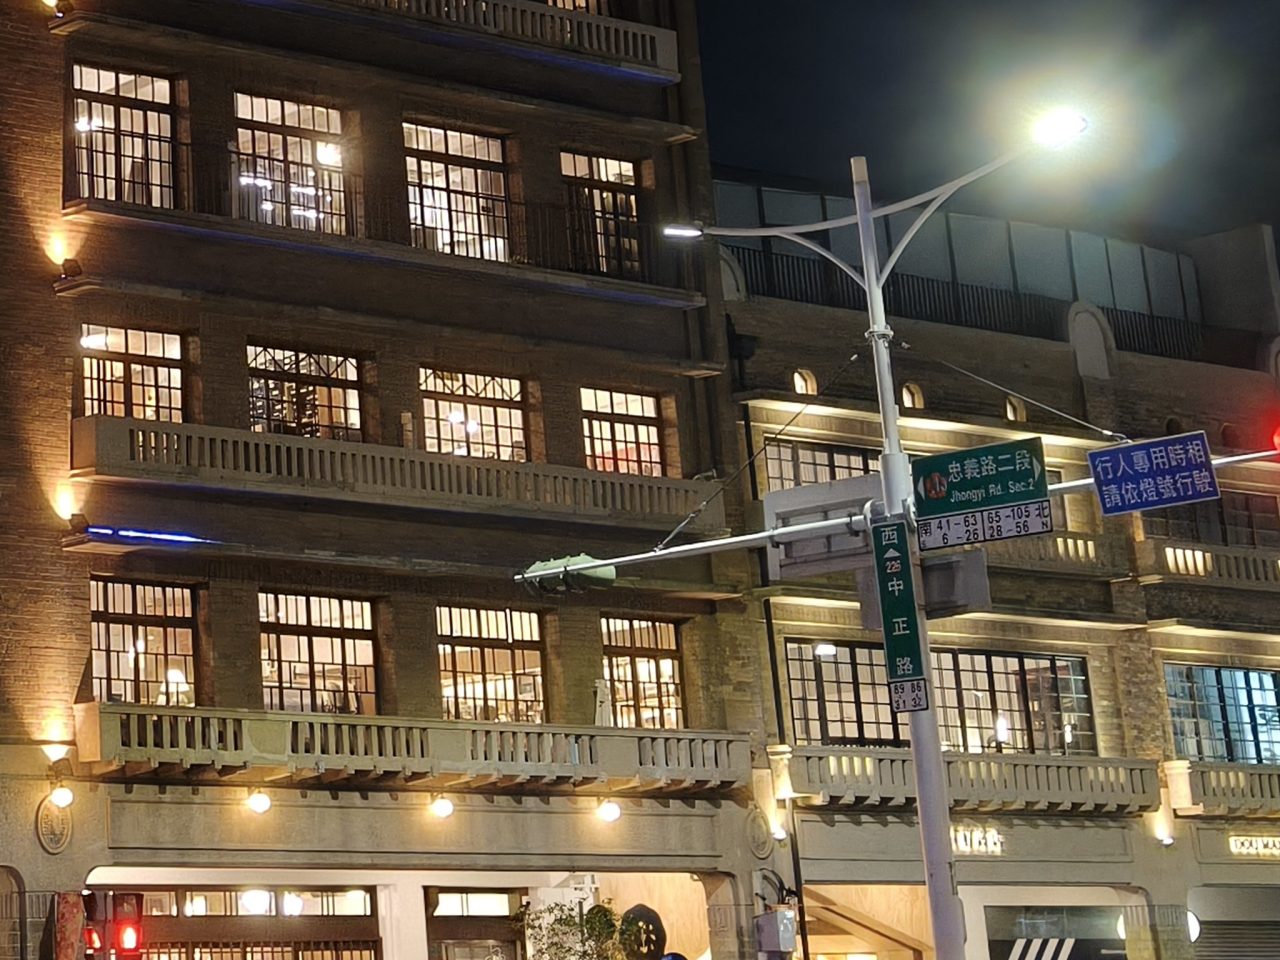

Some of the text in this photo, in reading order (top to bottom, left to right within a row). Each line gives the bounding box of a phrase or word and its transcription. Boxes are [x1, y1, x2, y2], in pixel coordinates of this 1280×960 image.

[948, 450, 1032, 483] 忠義路二段
[1095, 440, 1206, 480] 行人專用時相
[950, 487, 986, 503] Jhongyi
[1102, 468, 1214, 508] 請依燈號行駛
[1035, 505, 1049, 519] 北
[881, 526, 898, 546] 西
[888, 577, 913, 675] 中正路
